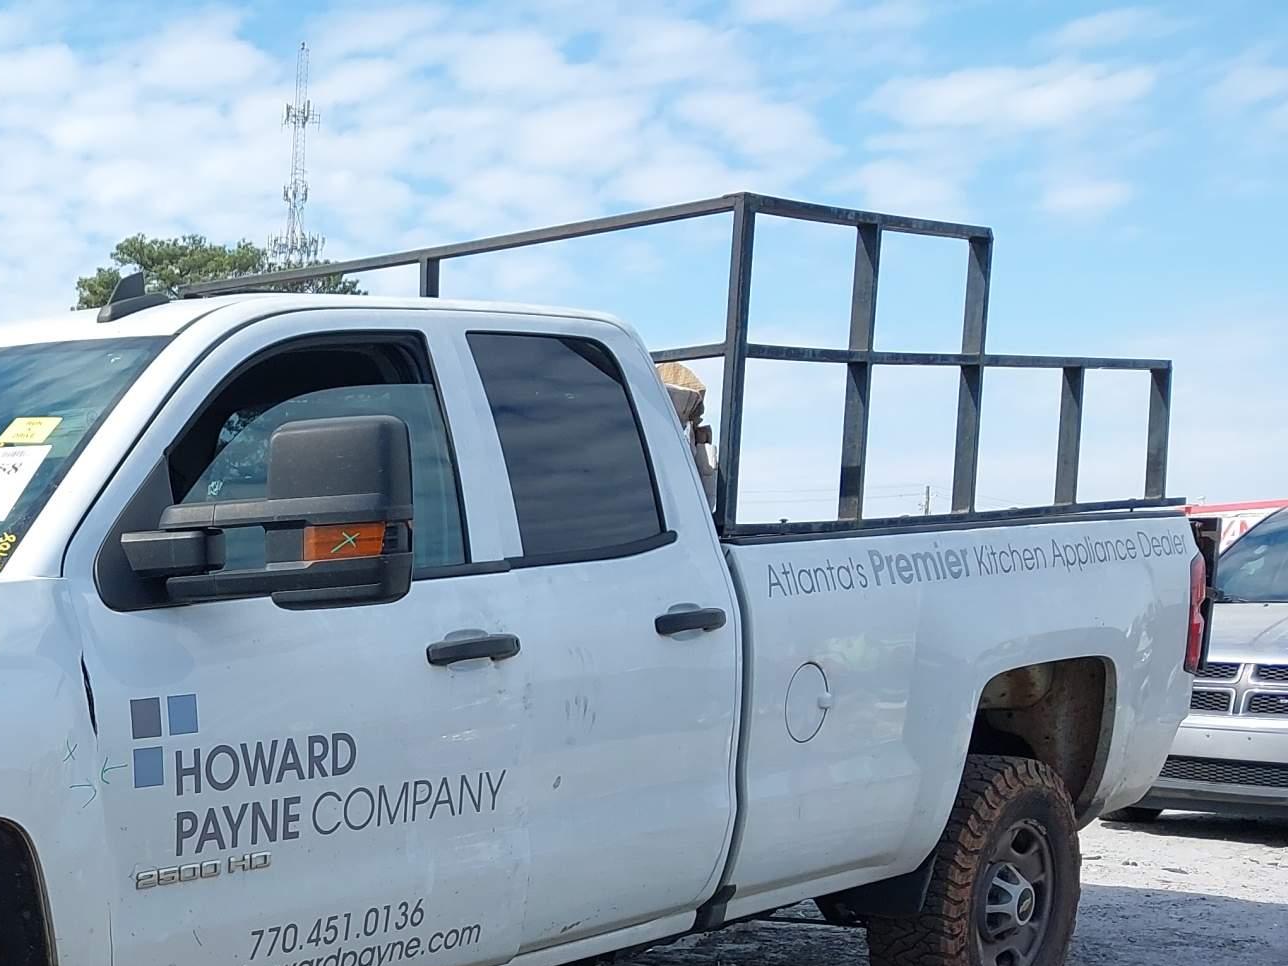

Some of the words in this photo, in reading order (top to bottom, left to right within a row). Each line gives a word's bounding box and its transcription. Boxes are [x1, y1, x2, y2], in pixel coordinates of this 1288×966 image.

[767, 559, 868, 598] Atlanta's
[868, 541, 971, 587] Premier
[975, 544, 1047, 577] Kitchen
[1051, 536, 1137, 573] Appliance
[1137, 531, 1187, 558] Dealer
[175, 732, 357, 796] HOWARD
[175, 796, 301, 857] PAYNE
[312, 769, 506, 835] COMPANY
[136, 859, 222, 889] 2500
[228, 850, 272, 873] HD
[249, 898, 425, 960] 770.451.0136
